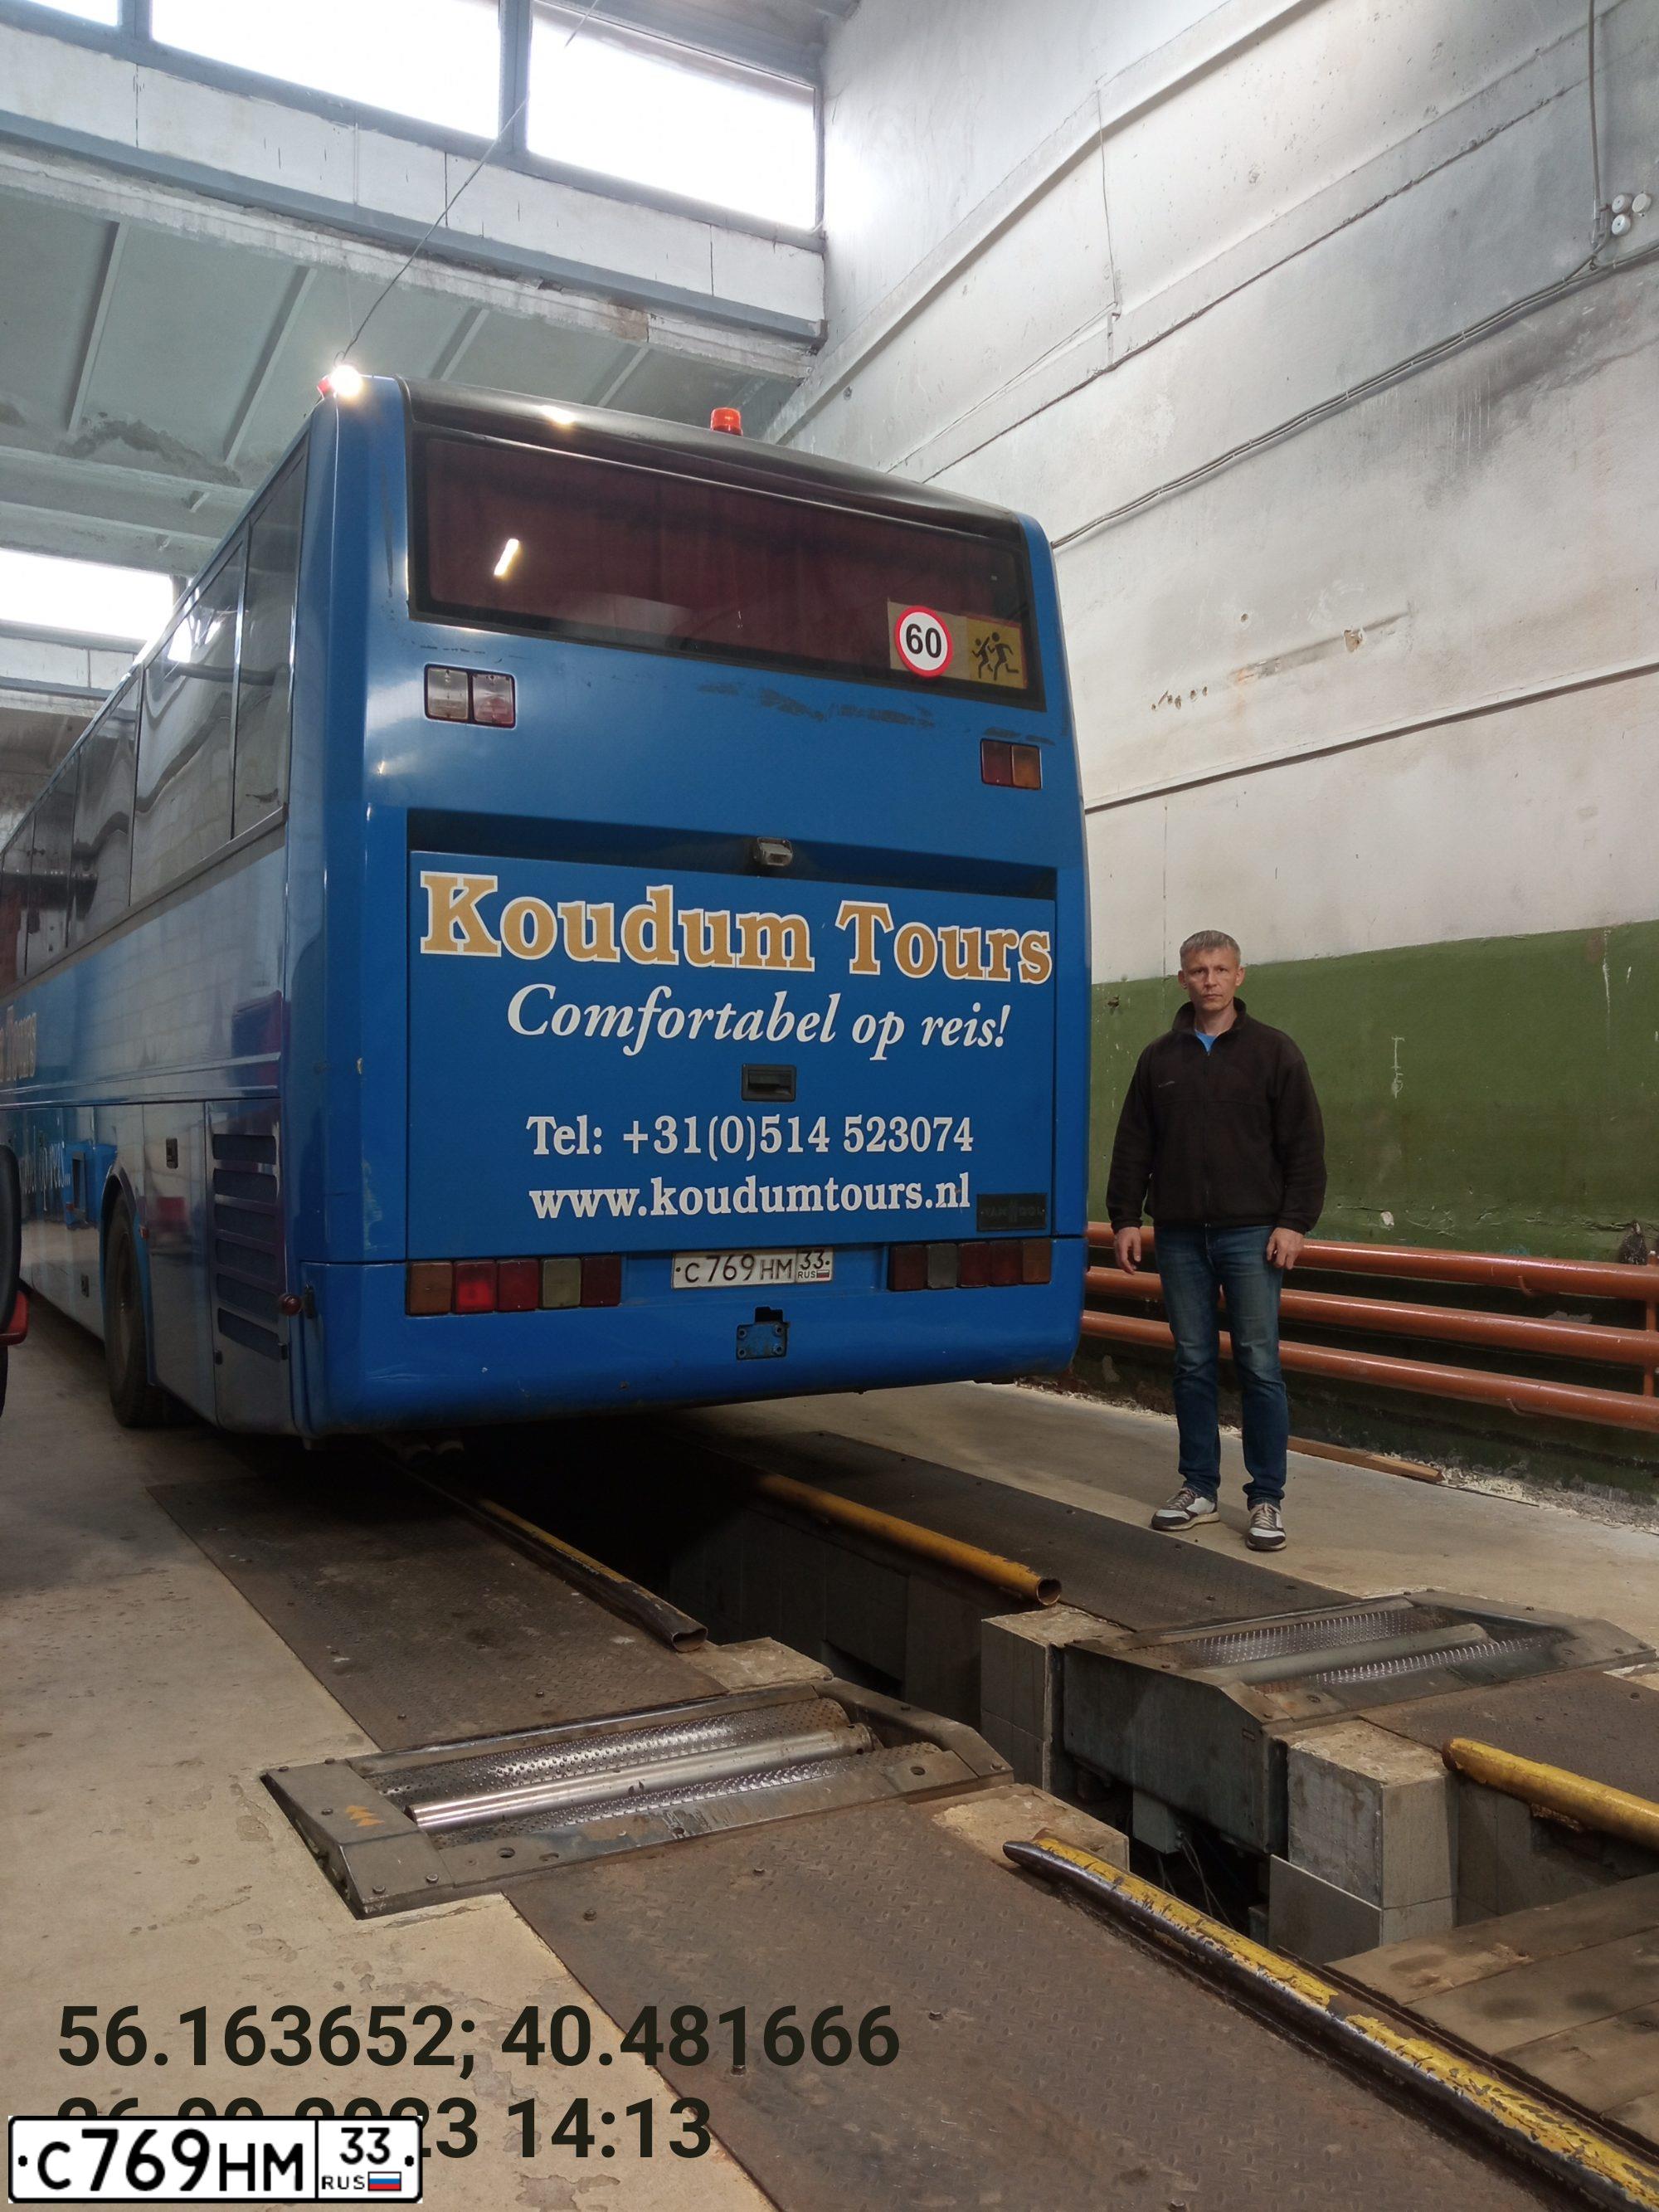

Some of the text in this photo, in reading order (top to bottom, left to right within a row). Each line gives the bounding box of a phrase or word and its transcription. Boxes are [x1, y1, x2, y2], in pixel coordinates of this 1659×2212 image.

[906, 624, 941, 658] 60
[420, 870, 1052, 984] Koudum Tours
[507, 983, 1011, 1061] Comfortabel op reis!
[526, 1114, 974, 1162] Tel: +31(0)514 523074
[528, 1172, 971, 1219] www.koudumtours.nl
[797, 1270, 816, 1279] RUS
[800, 1250, 825, 1270] 33
